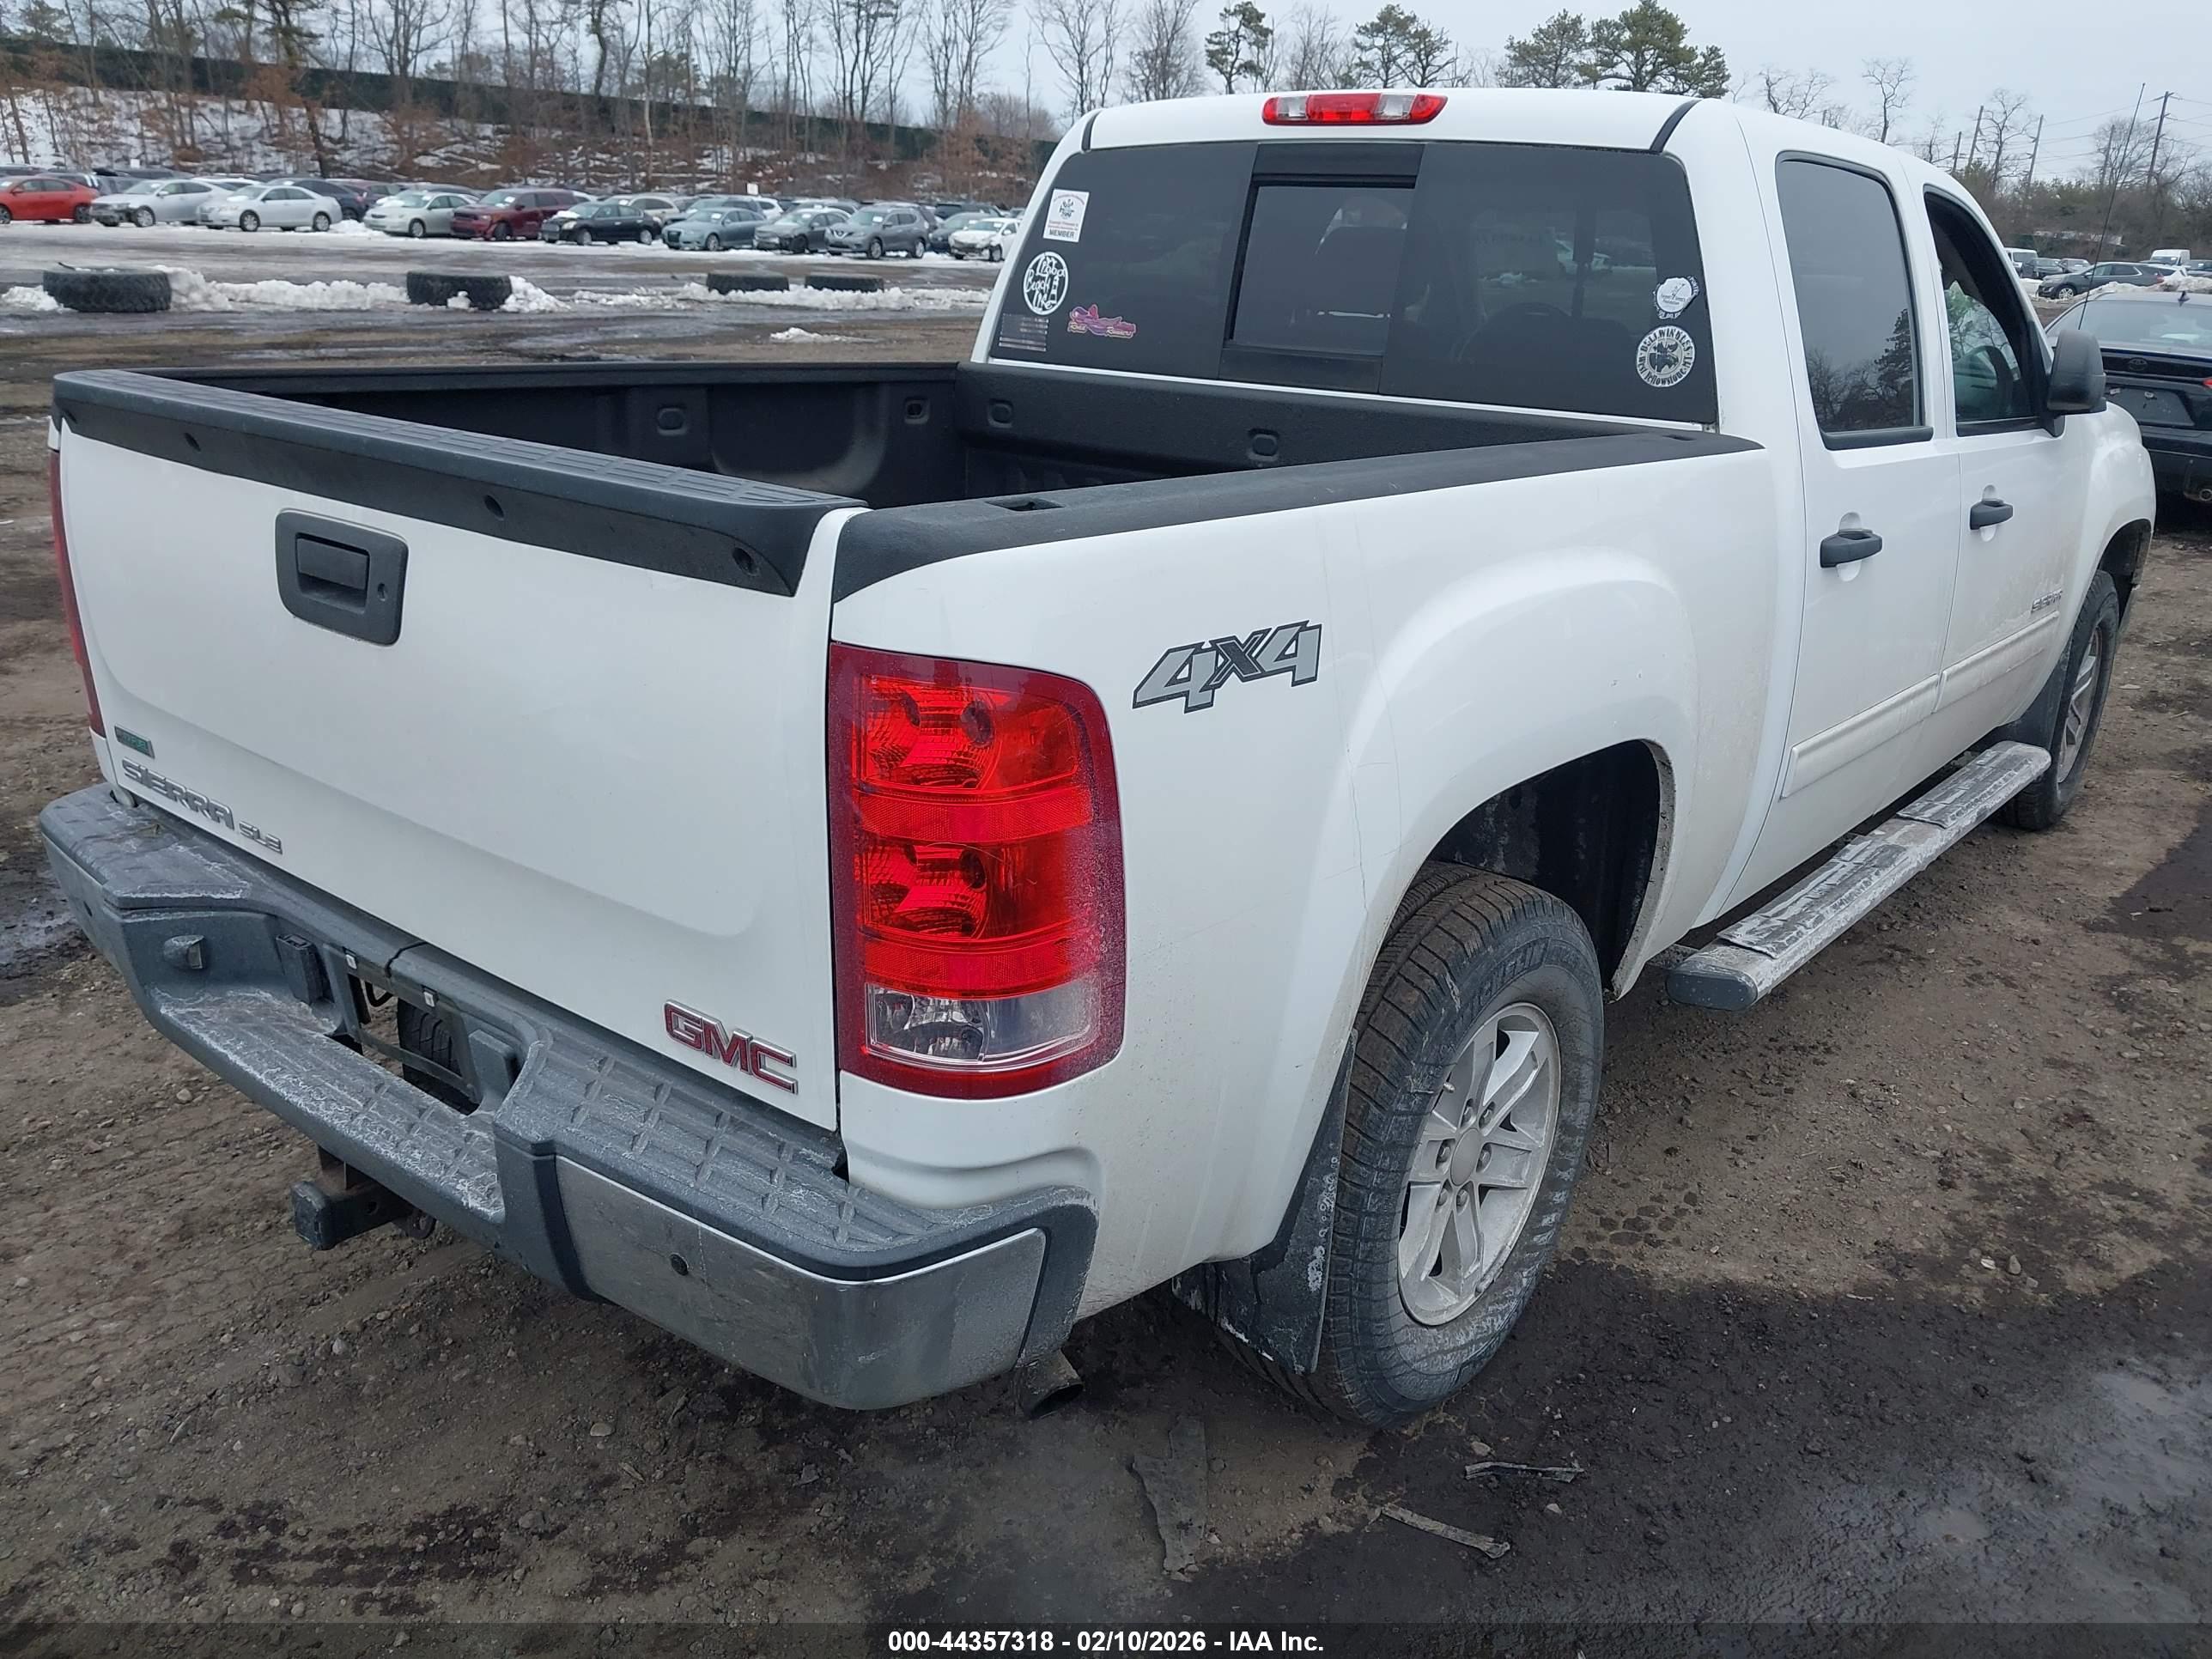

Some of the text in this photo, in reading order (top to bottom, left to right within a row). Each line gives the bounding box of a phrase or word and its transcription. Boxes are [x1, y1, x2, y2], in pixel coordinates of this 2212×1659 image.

[1048, 228, 1075, 238] MEMBER
[1644, 368, 1687, 386] Yellowstone
[122, 757, 234, 830] SIERRA
[239, 820, 283, 854] SLE
[663, 999, 799, 1095] GMC
